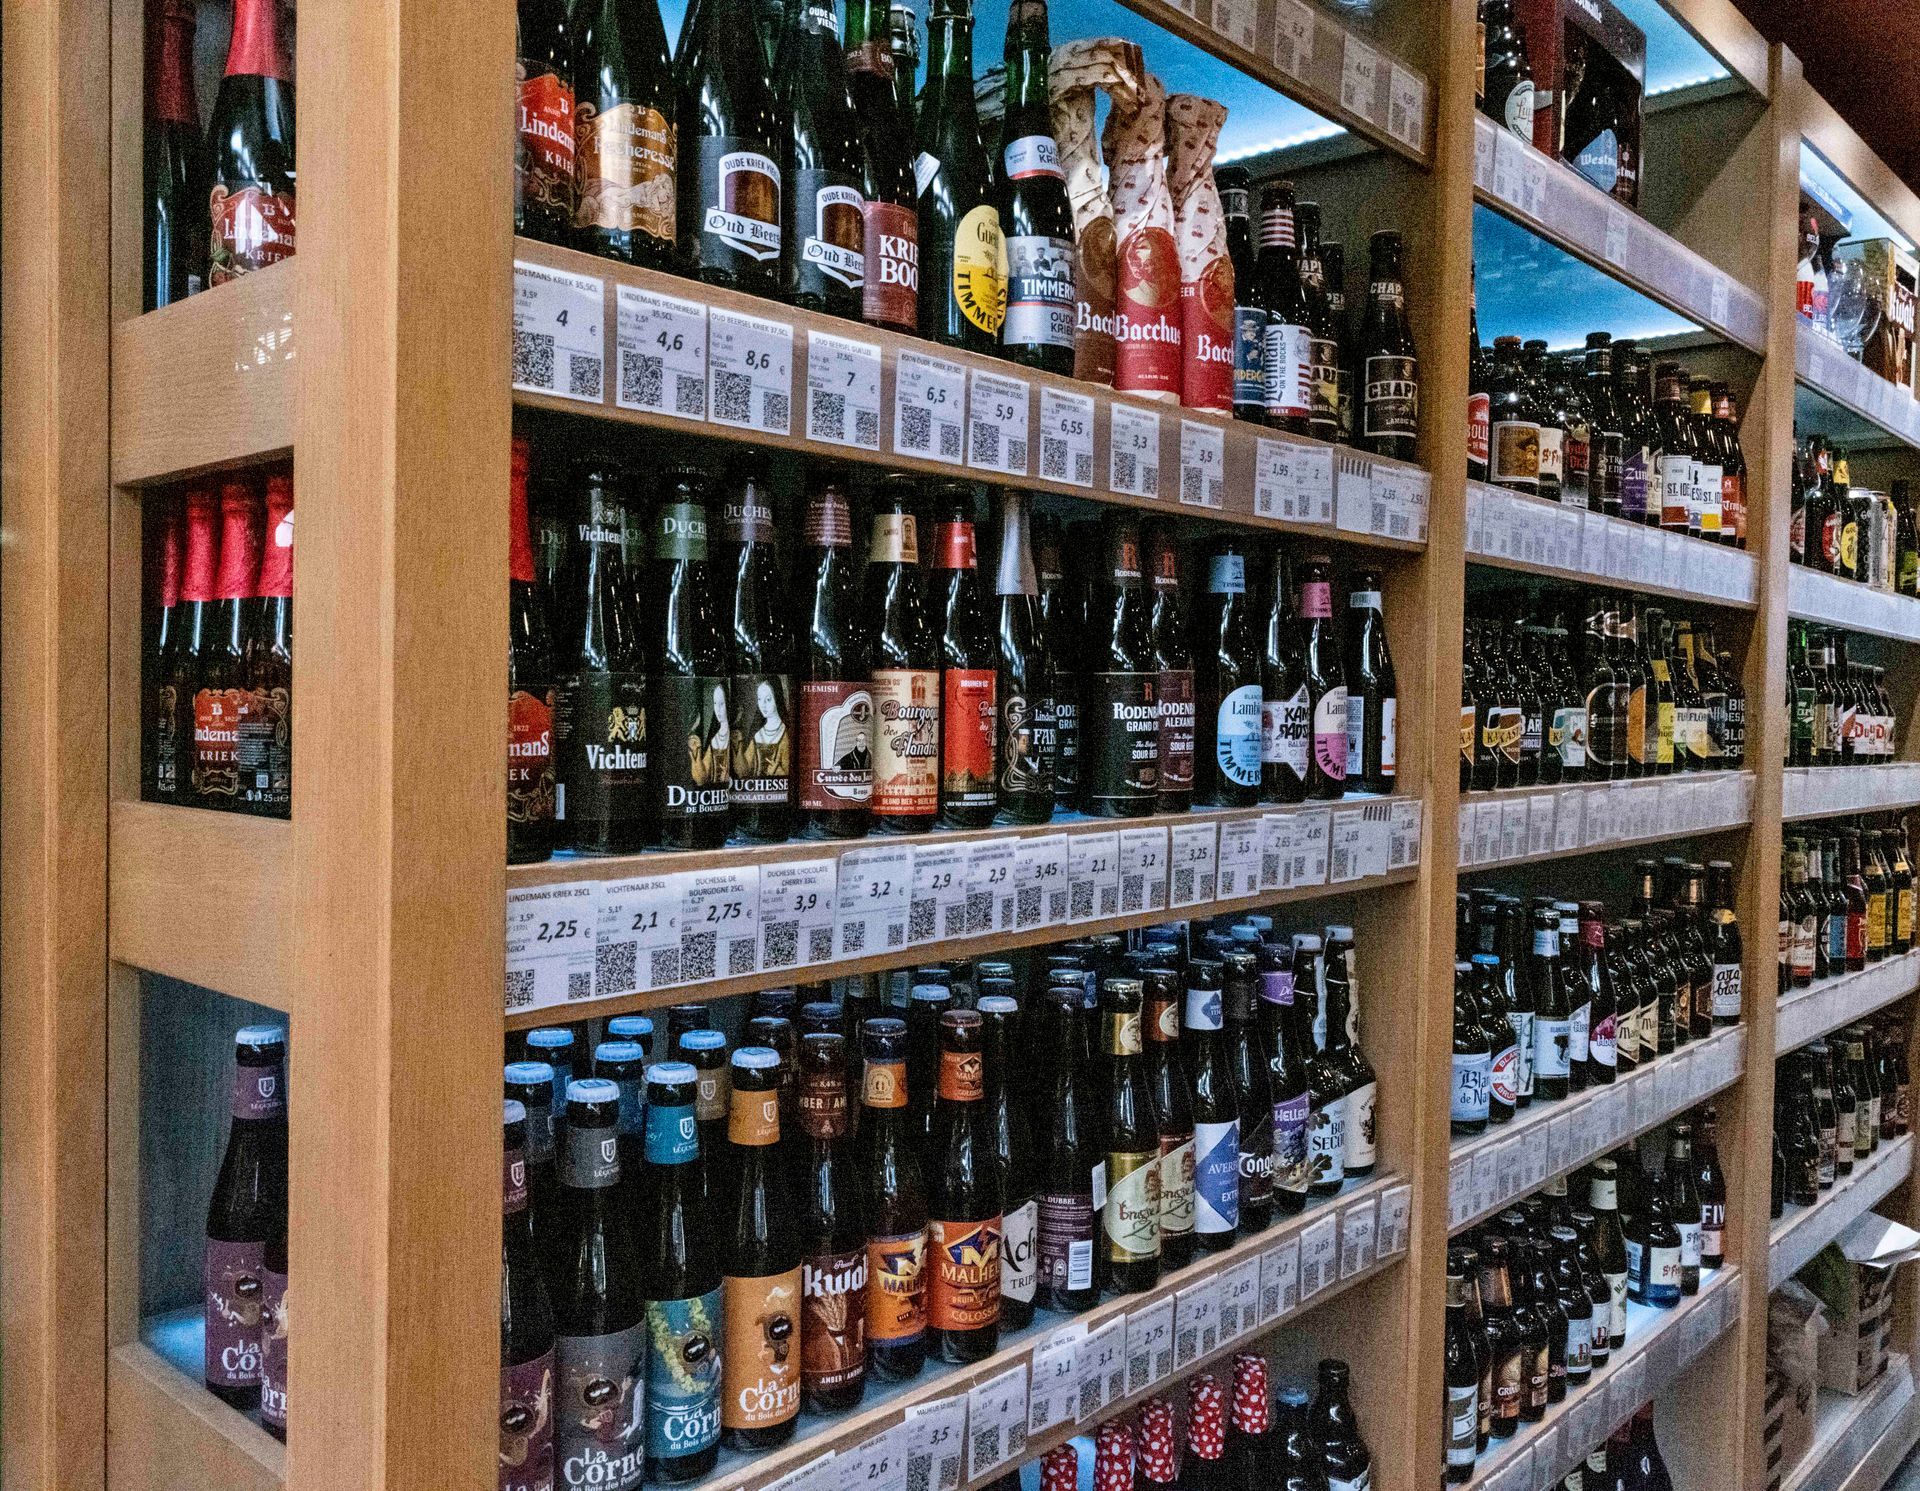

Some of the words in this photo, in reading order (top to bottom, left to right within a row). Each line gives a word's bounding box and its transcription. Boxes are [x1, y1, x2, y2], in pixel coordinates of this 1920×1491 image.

[725, 158, 745, 170] OUDE
[709, 215, 744, 235] Oud
[812, 244, 840, 264] Oud
[557, 310, 568, 328] 4
[656, 331, 684, 352] 4,6
[745, 350, 770, 370] 8,6
[846, 372, 855, 387] 7
[926, 386, 946, 406] 6,5
[995, 404, 1014, 421] 5,9
[1060, 418, 1083, 437] 6,55
[1132, 434, 1148, 450] 3,3
[1199, 449, 1213, 465] 3,9
[1272, 463, 1289, 478] 1,95
[1188, 847, 1208, 863] 3,25
[1237, 840, 1252, 856] 3,5
[1091, 858, 1107, 875] 2,1
[1140, 853, 1156, 870] 3,2
[988, 866, 1007, 885] 2,9
[1034, 862, 1058, 881] 3,45
[606, 883, 650, 895] VICHTENAAR
[869, 880, 891, 899] 3,2
[931, 873, 952, 892] 2,9
[509, 891, 551, 903] LINDEMANS
[553, 889, 573, 899] KRIEK
[794, 893, 818, 914] 3,9
[632, 911, 659, 933] 2,1
[669, 916, 677, 929] €
[706, 902, 743, 924] 2,75
[746, 909, 753, 920] €
[537, 918, 579, 945] 2,25
[584, 927, 592, 940] €
[1143, 1325, 1165, 1346] 2,75
[1097, 1347, 1114, 1368] 3,1
[1054, 1358, 1072, 1379] 3,1
[758, 1379, 779, 1394] La
[1000, 1398, 1009, 1413] 4
[929, 1425, 951, 1446] 3,5
[563, 1445, 644, 1486] Corne
[584, 1447, 609, 1466] La
[866, 1456, 889, 1481] 2,6
